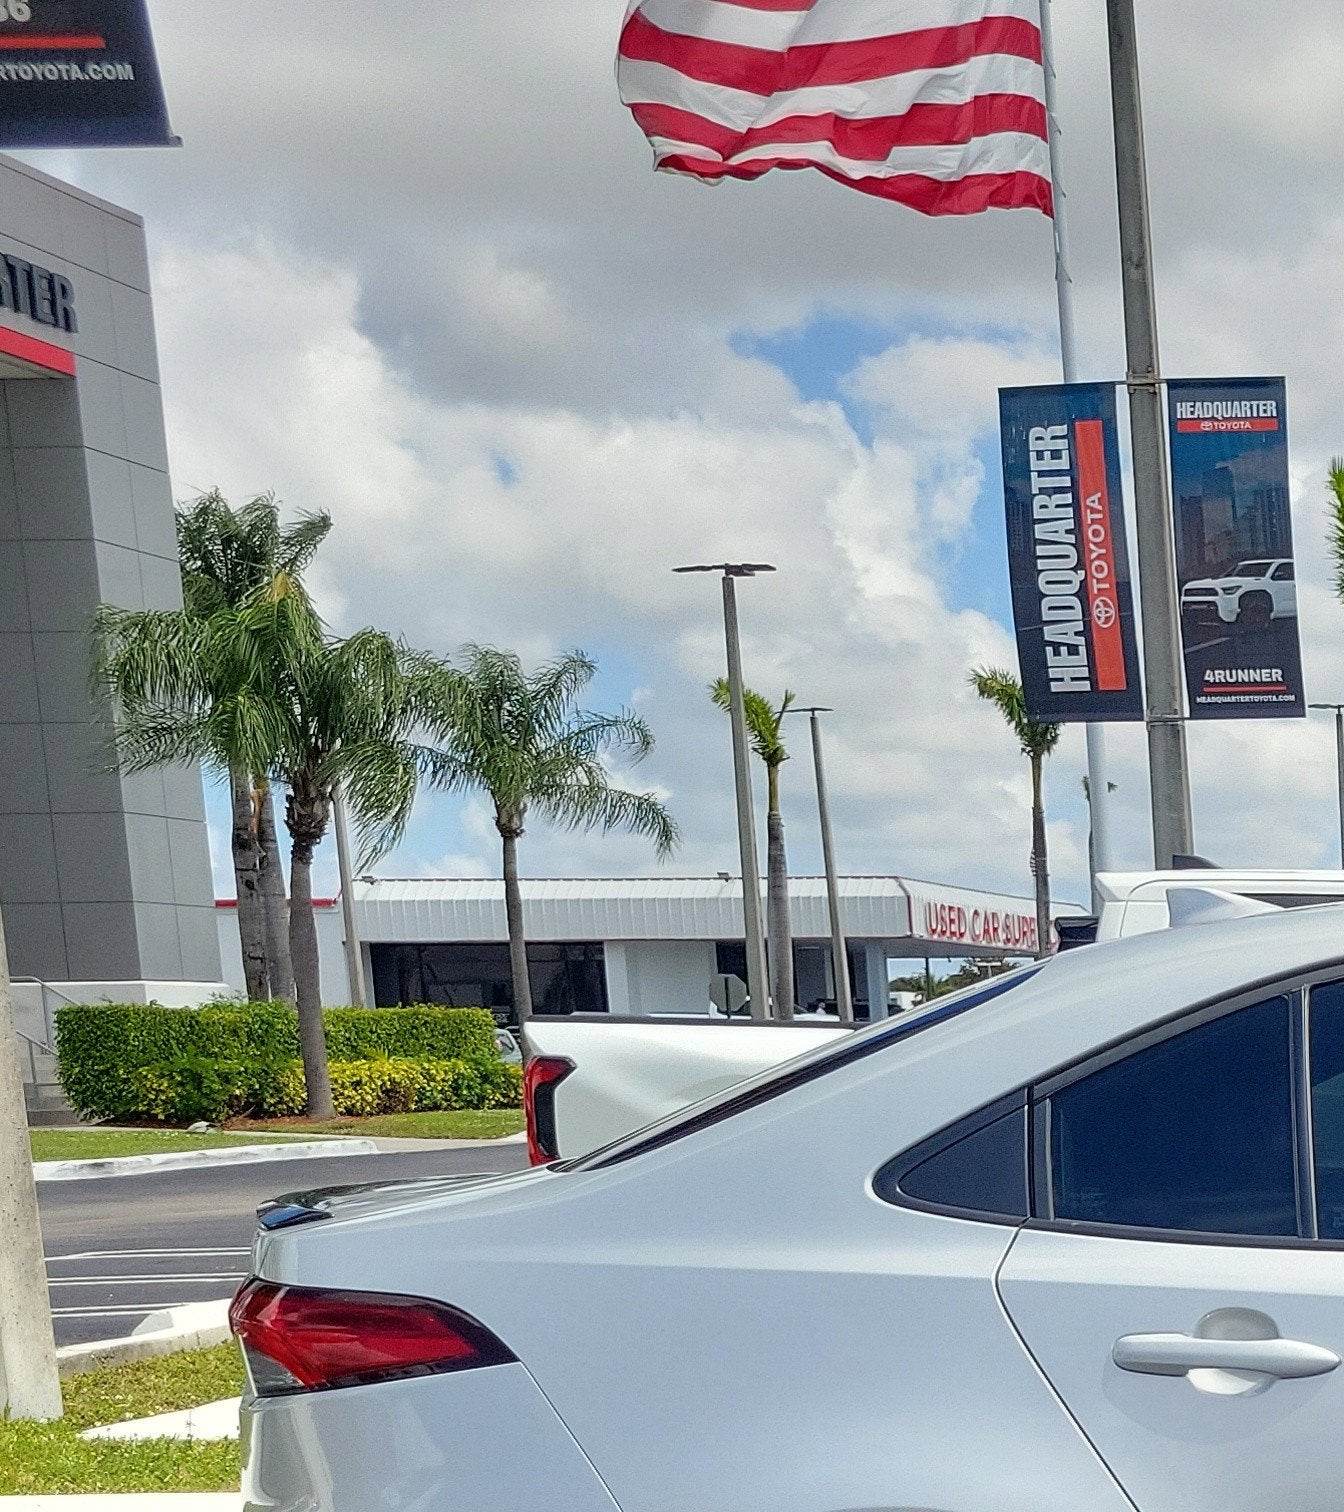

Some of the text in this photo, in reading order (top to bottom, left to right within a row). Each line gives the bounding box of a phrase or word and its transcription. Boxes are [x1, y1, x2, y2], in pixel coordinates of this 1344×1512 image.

[1176, 400, 1278, 419] HEADQUARTER
[1213, 420, 1252, 430] TOYOTA
[1028, 423, 1092, 692] HEADQUARTER
[1086, 492, 1110, 593] TOYOTA
[1203, 668, 1283, 684] 4RUNNER
[925, 901, 967, 939] USED
[971, 908, 1001, 943] CAR
